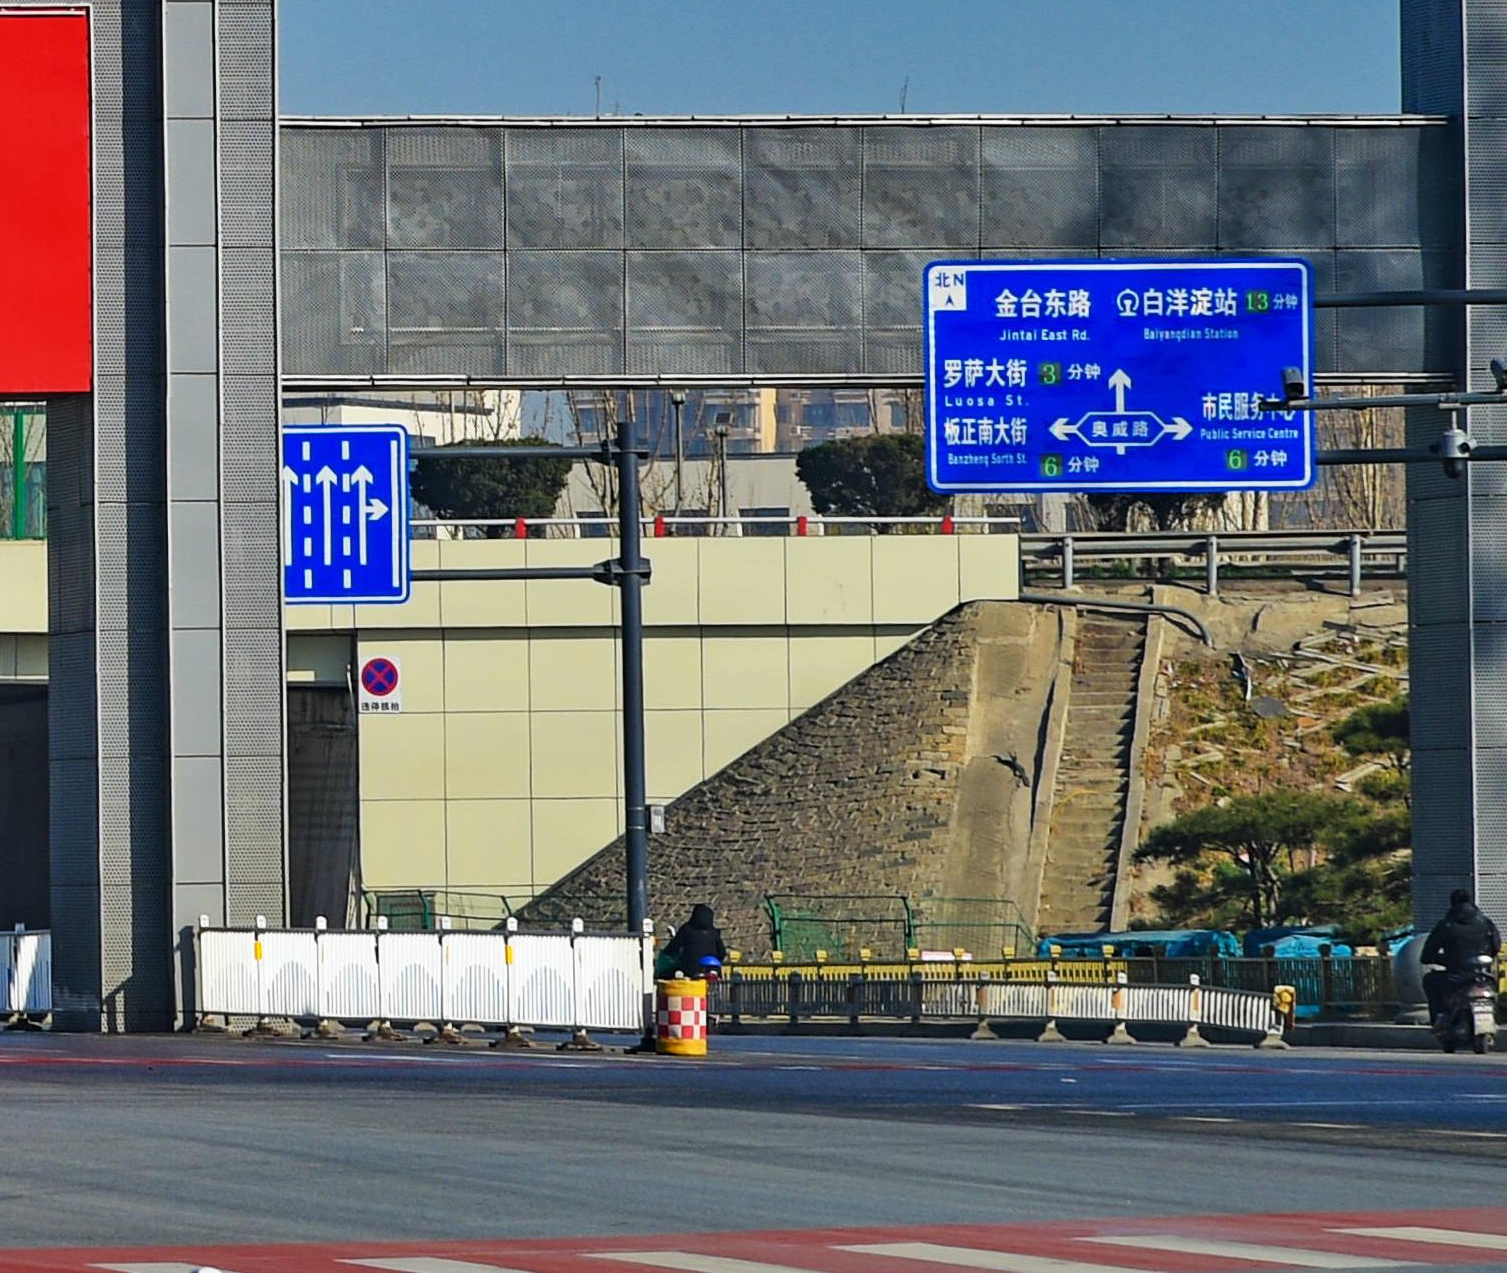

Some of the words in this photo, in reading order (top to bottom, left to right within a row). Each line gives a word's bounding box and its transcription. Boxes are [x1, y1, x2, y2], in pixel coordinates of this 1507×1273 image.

[935, 272, 951, 288] 北
[953, 273, 965, 287] N
[995, 288, 1091, 318] 金台东路
[1143, 287, 1238, 317] 白洋淀站
[1246, 292, 1269, 310] 13
[1273, 293, 1298, 310] 分钟
[999, 329, 1037, 341] Jintai
[1041, 329, 1067, 341] East
[1072, 329, 1090, 341] Rd.
[1205, 328, 1238, 339] Station
[943, 358, 1027, 388] 罗萨大街
[1043, 364, 1056, 384] 3
[1067, 363, 1101, 380] 分钟
[945, 395, 995, 407] Luosa
[1006, 394, 1029, 407] St.
[943, 416, 1027, 446] 板正南大街
[1092, 420, 1148, 437] 奥威路
[1200, 428, 1230, 439] Public
[1232, 428, 1265, 439] Service
[1268, 428, 1298, 439] Centre
[1045, 457, 1057, 476] 6
[1068, 456, 1099, 473] 分钟
[1229, 449, 1242, 469] 6
[1254, 449, 1287, 466] 分钟
